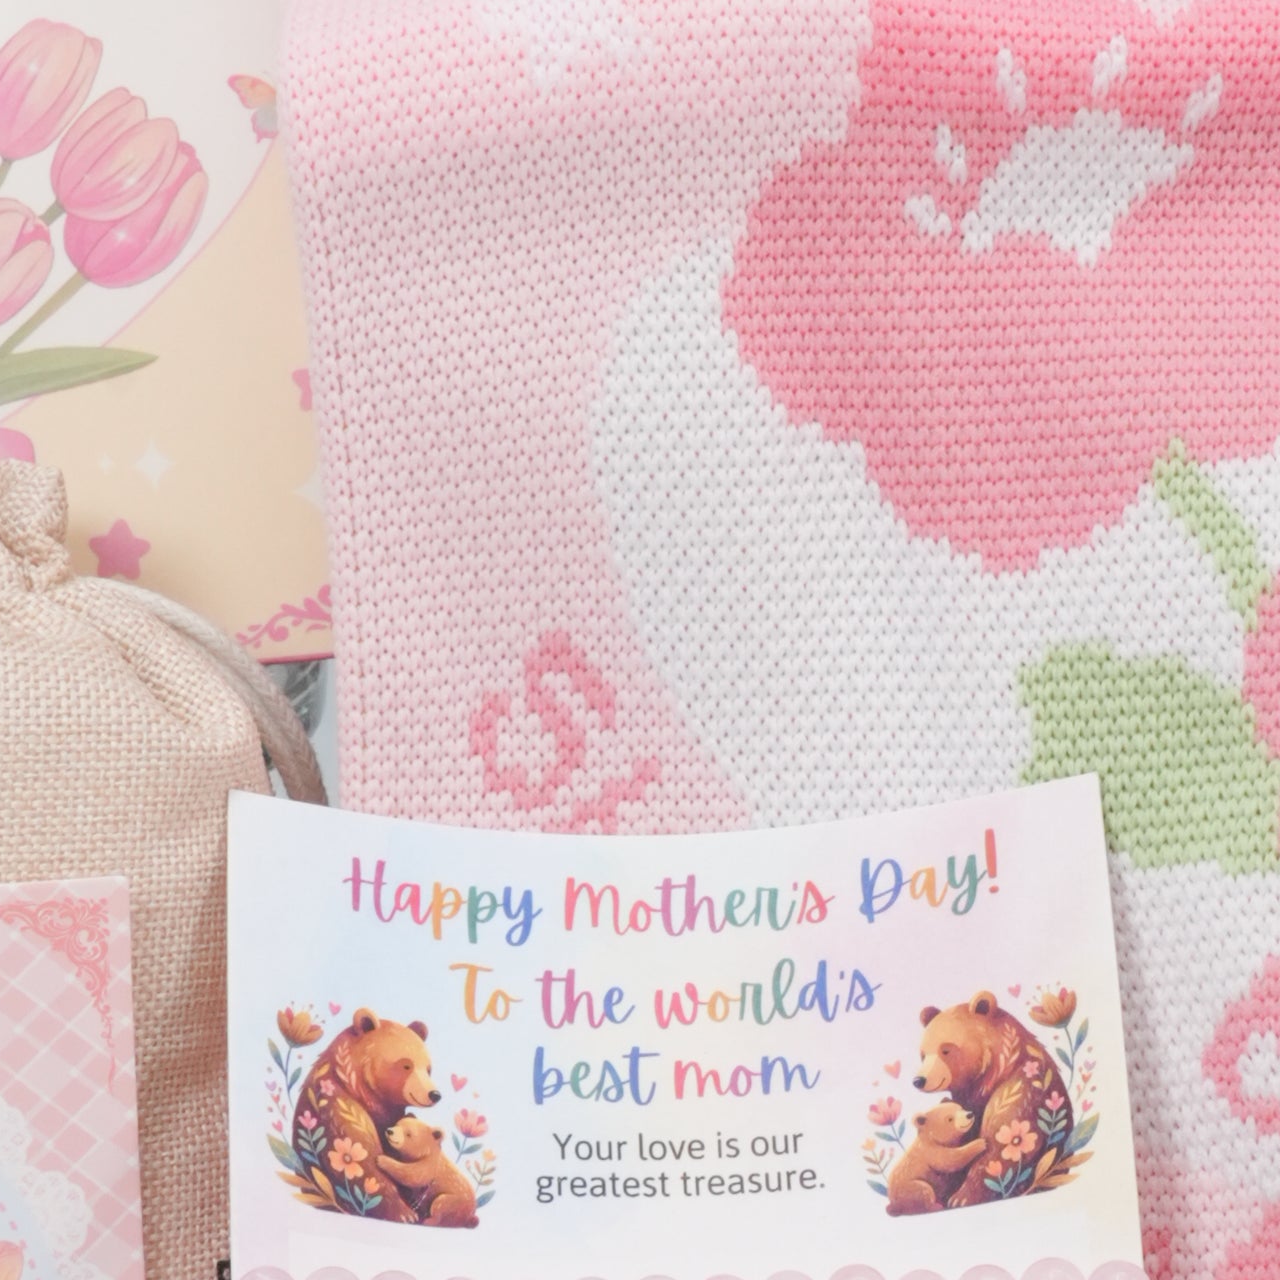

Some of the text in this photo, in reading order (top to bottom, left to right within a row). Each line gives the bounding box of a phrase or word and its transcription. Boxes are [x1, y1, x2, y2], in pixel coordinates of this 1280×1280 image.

[343, 828, 1000, 946] Happy Mother's Day!
[449, 958, 882, 1029] To the world's
[534, 1046, 821, 1105] best mom
[553, 1128, 804, 1161] Your love is our
[535, 1163, 826, 1203] greatest treasure.
